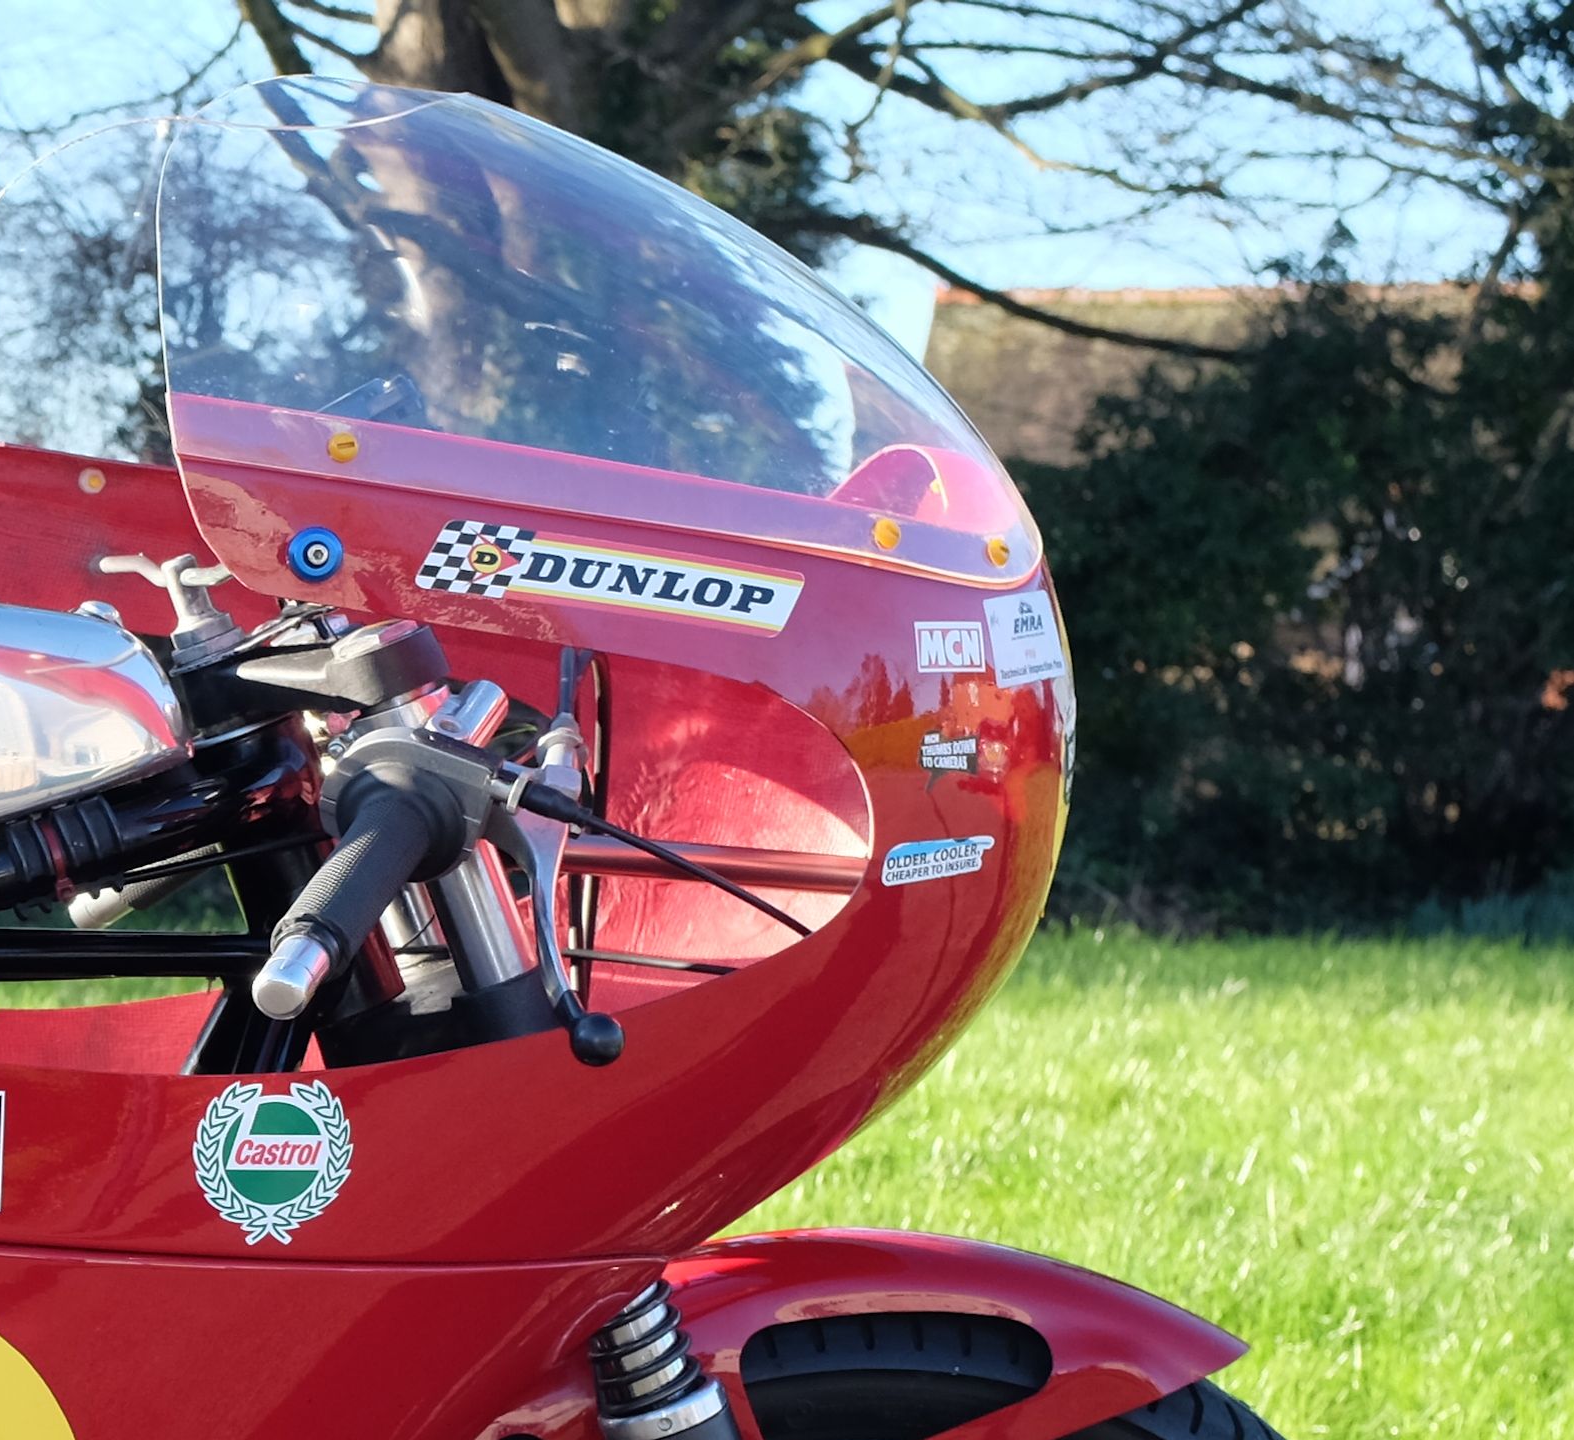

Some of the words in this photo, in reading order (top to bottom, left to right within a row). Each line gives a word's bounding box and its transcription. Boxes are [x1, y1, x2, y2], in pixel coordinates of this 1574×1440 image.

[520, 551, 776, 614] DUNLOP
[1013, 614, 1044, 635] EMRA
[920, 629, 981, 667] MCN
[885, 866, 929, 883] CHEAPER
[932, 864, 943, 875] TO
[235, 1139, 322, 1166] Castrol
